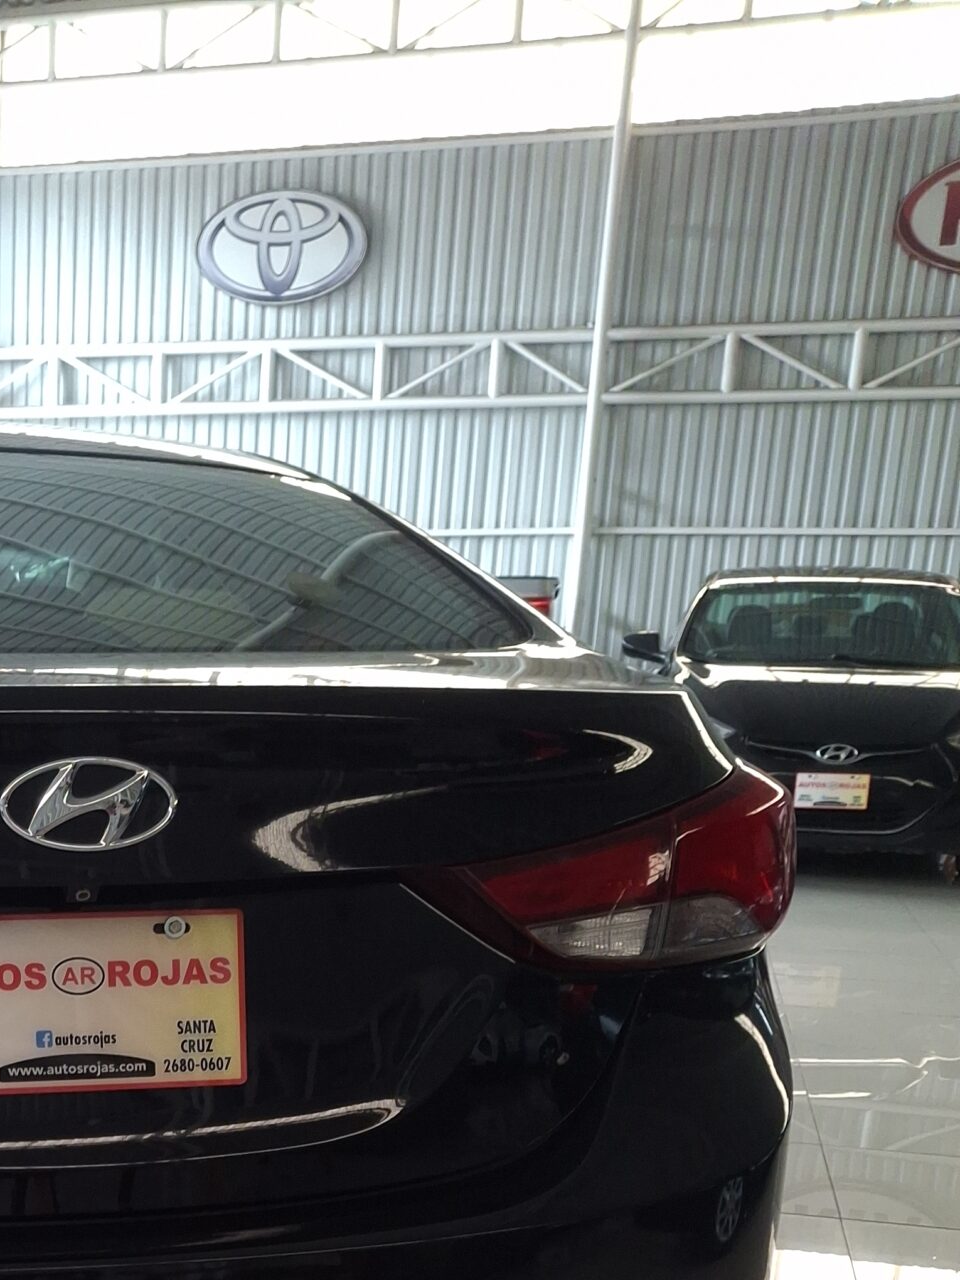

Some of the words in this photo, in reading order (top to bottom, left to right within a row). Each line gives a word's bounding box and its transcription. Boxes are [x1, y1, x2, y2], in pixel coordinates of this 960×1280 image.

[61, 966, 97, 986] AR
[107, 957, 232, 988] ROJAS
[177, 1020, 216, 1035] SANTA
[55, 1031, 117, 1048] autosrojas
[180, 1038, 213, 1054] CRUZ
[8, 1060, 147, 1078] www.autosrojas.com
[164, 1057, 232, 1073] 2680-0607
